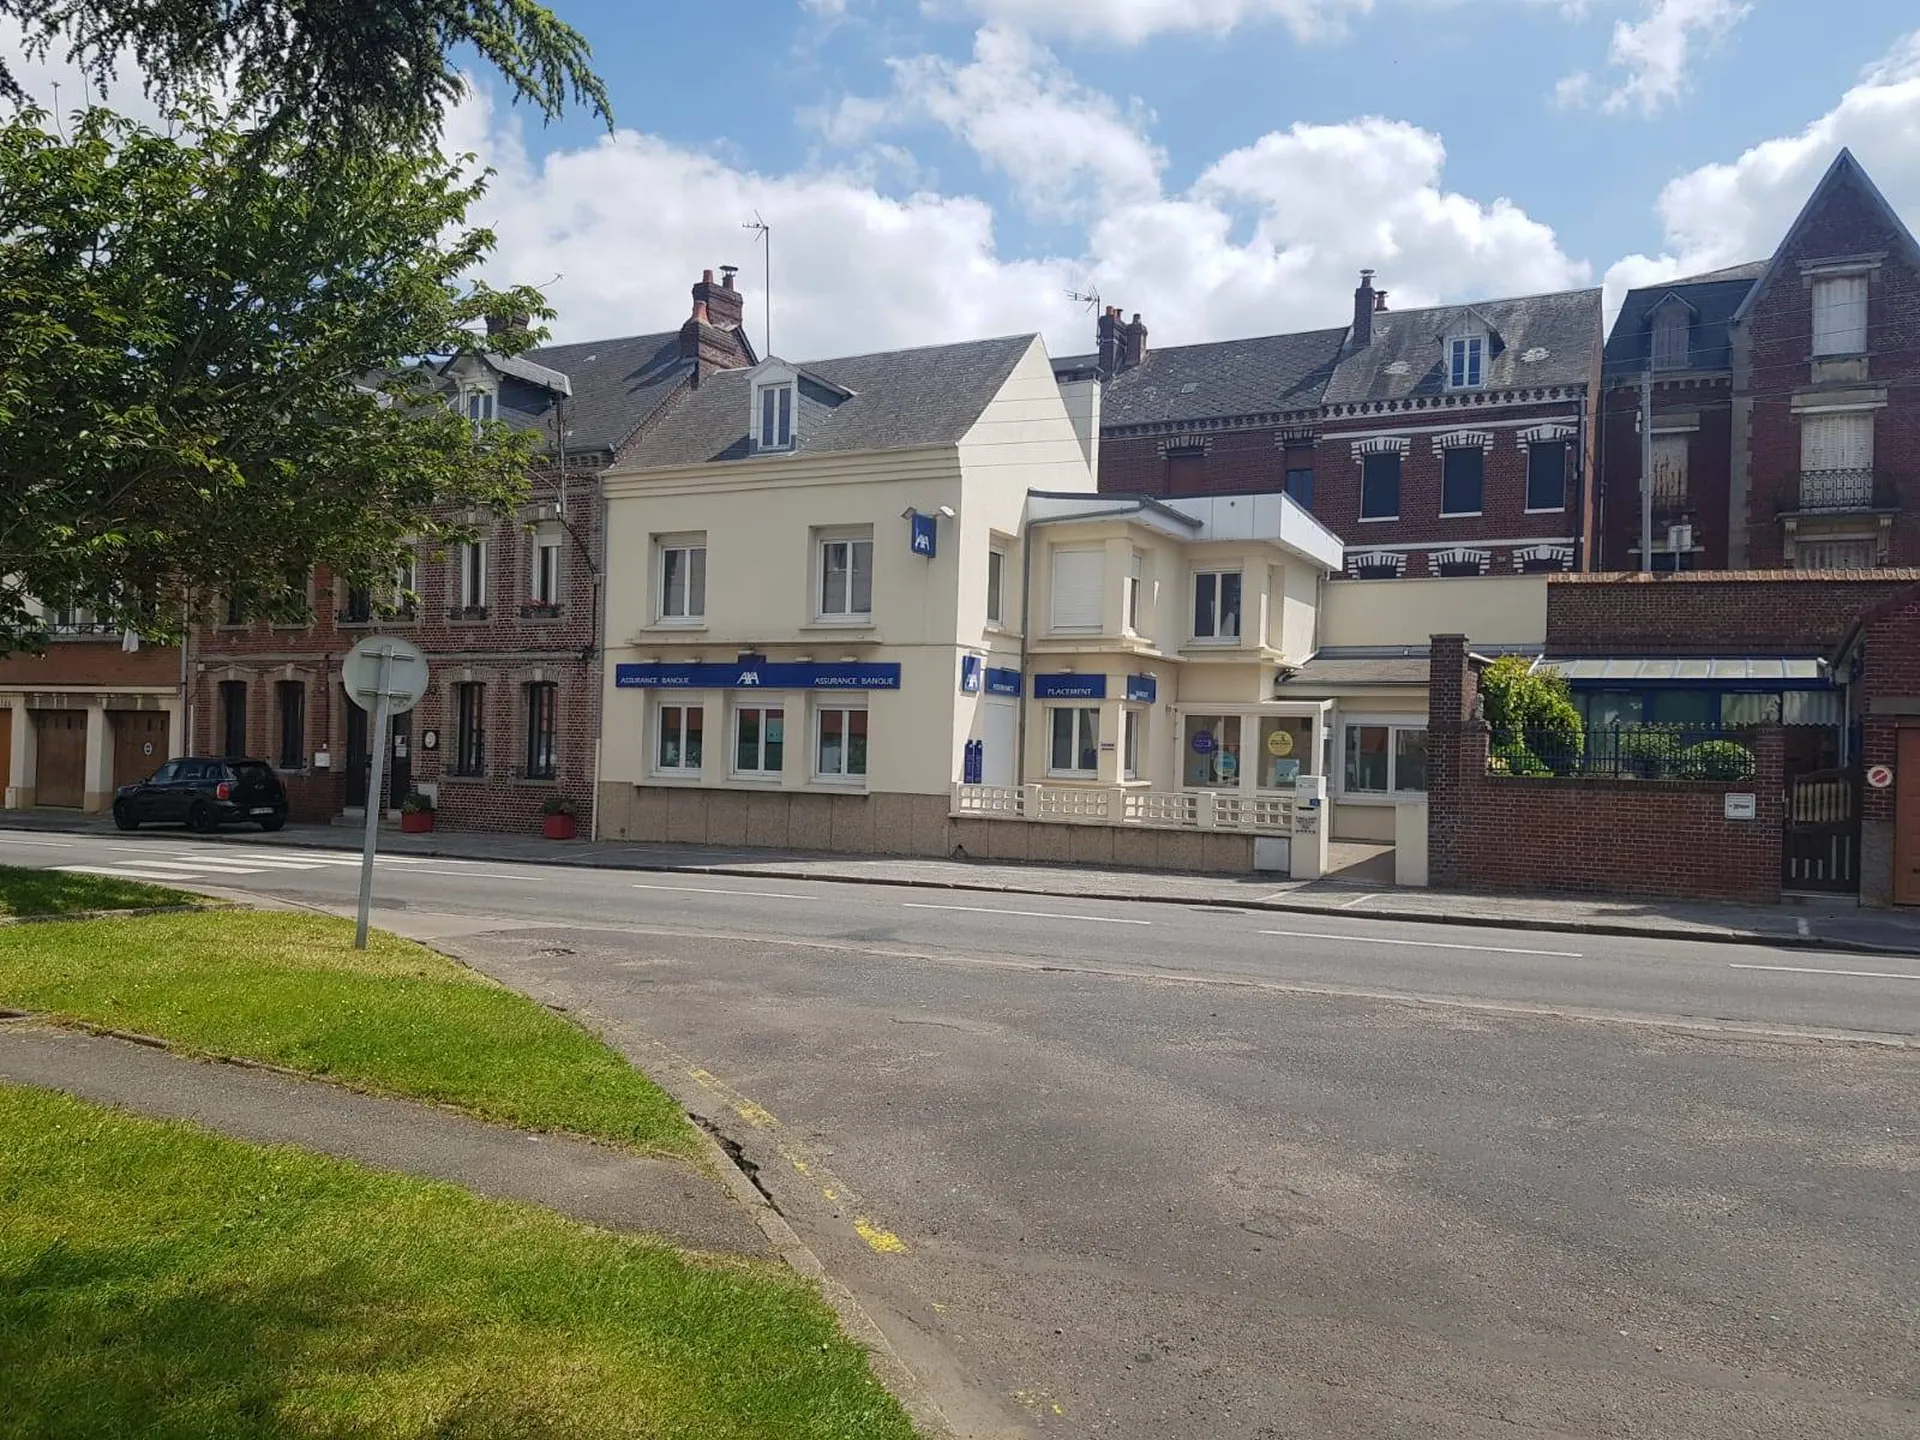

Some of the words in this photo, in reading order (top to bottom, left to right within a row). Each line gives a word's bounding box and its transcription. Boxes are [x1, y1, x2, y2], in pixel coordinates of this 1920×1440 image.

[915, 533, 930, 551] AXA
[736, 671, 760, 685] AXA
[861, 677, 894, 685] BANQUE
[1047, 688, 1092, 696] PLACEMENT
